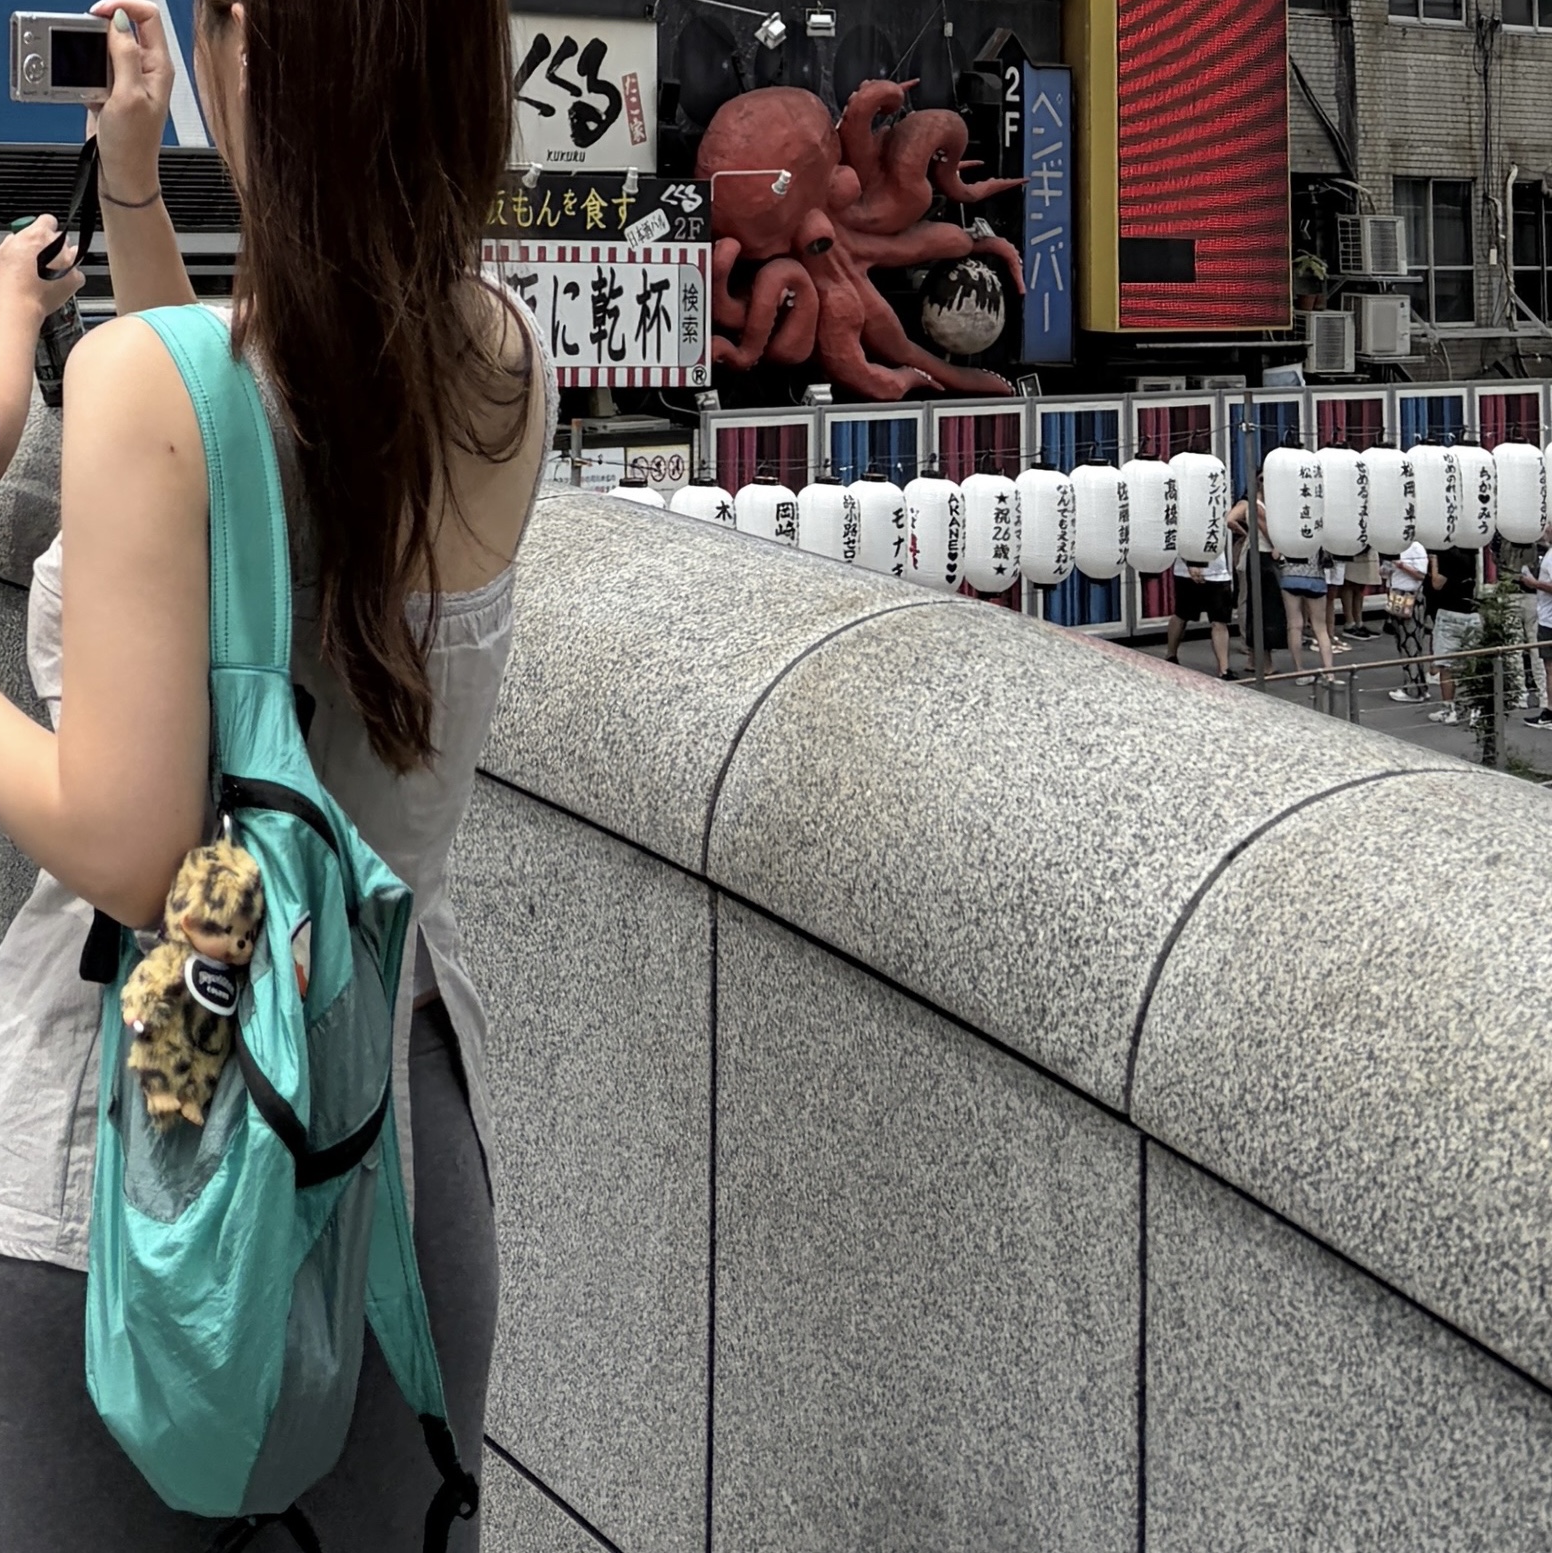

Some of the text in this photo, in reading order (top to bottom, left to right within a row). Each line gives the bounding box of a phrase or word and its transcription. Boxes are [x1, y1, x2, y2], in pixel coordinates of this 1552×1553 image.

[514, 33, 623, 148] くくる
[1004, 66, 1020, 147] 2F
[674, 217, 704, 241] 2F
[1030, 91, 1064, 333] ペンギンバー
[682, 282, 699, 344] 検索
[774, 501, 796, 546] 岡崎
[948, 493, 961, 551] AKANE
